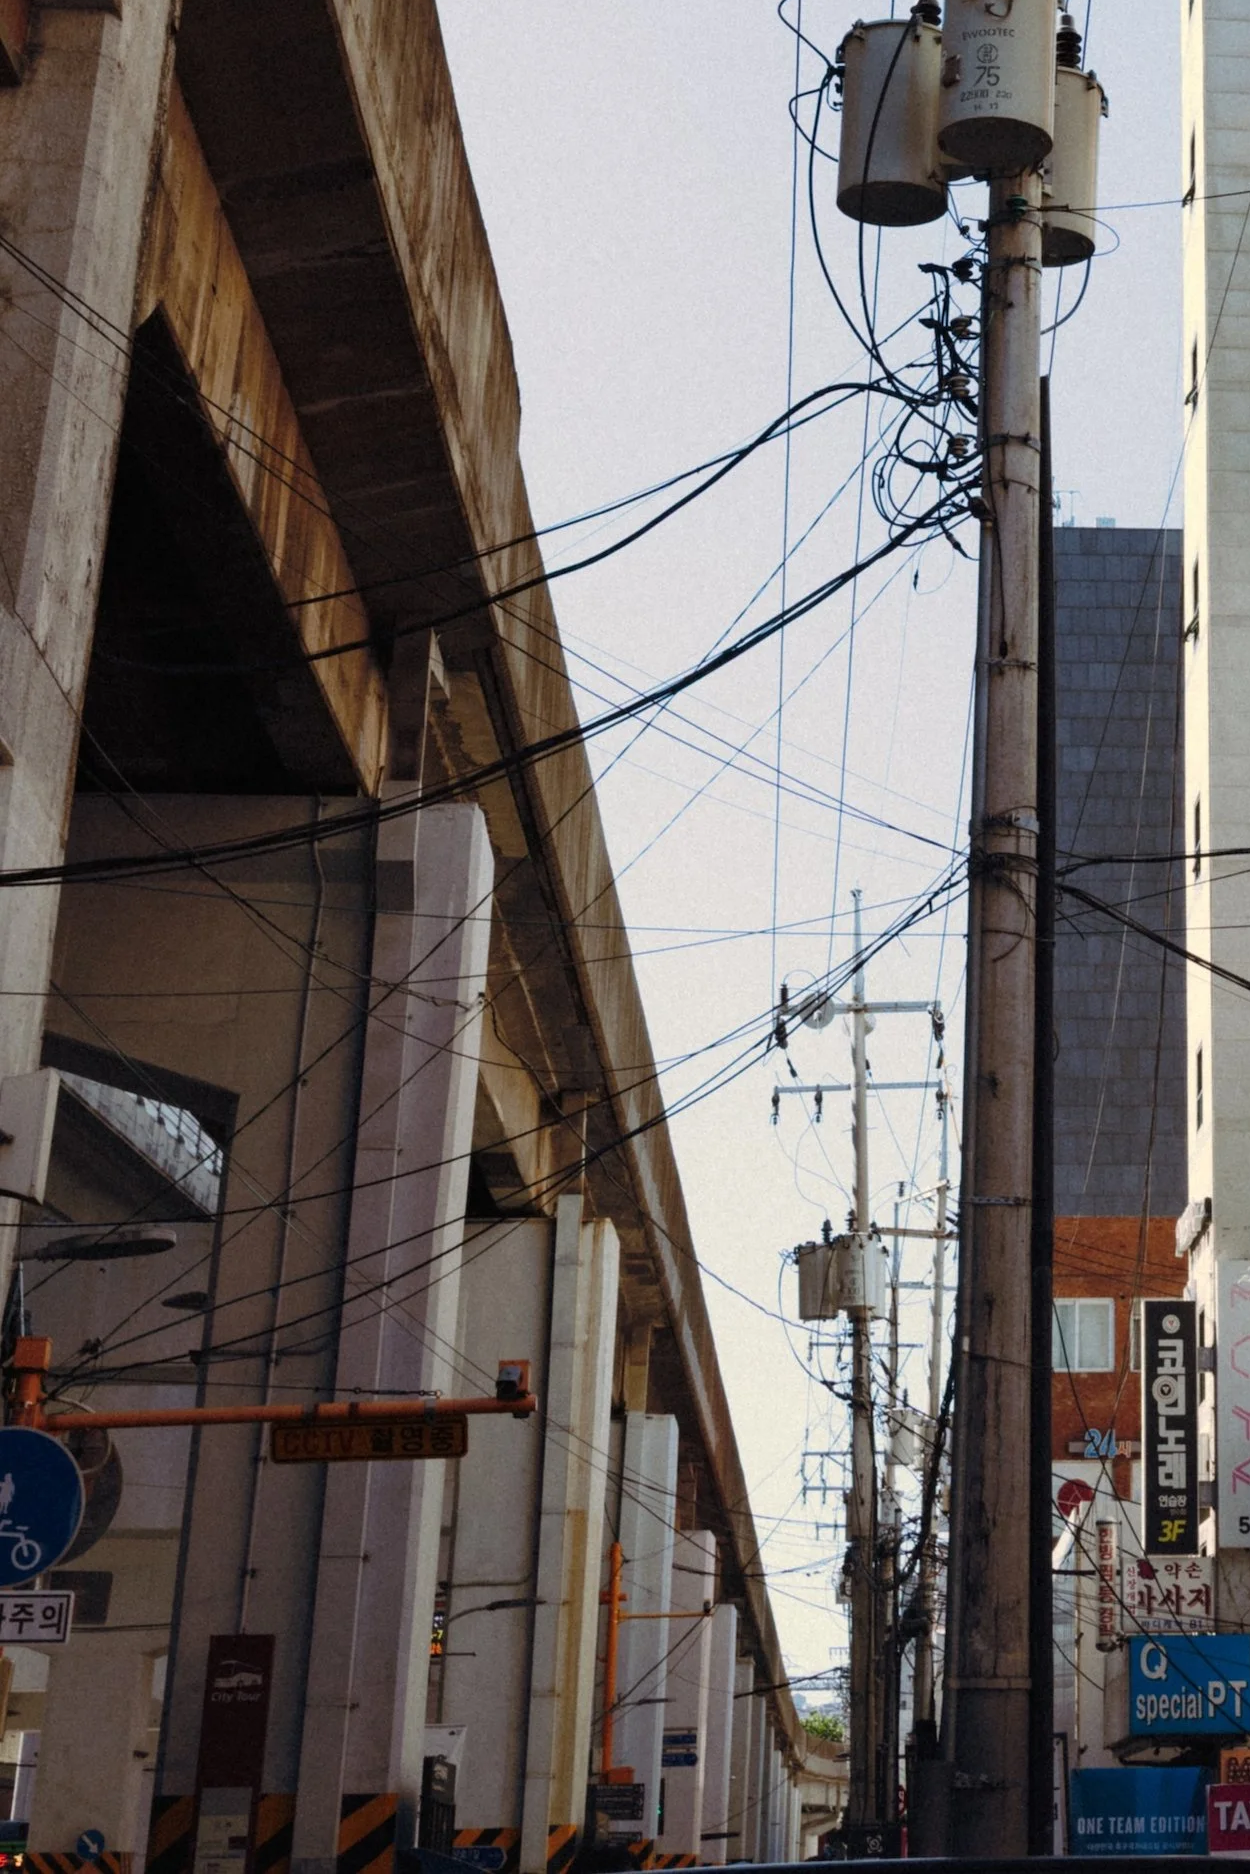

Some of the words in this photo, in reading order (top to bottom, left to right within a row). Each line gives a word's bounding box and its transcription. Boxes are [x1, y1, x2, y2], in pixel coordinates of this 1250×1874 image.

[973, 65, 1001, 87] 75
[1151, 1338, 1187, 1490] 코인노래
[1084, 1428, 1132, 1459] 24시
[1157, 1495, 1187, 1508] 연습장
[1157, 1518, 1187, 1544] 3F
[1164, 1561, 1203, 1580] 약손
[0, 1602, 65, 1635] 주의
[1139, 1641, 1169, 1682] Q
[1135, 1684, 1203, 1726] special
[1207, 1680, 1248, 1718] PT
[1076, 1817, 1105, 1835] ONE
[1108, 1816, 1146, 1834] TEAM
[1150, 1815, 1206, 1834] EDITION
